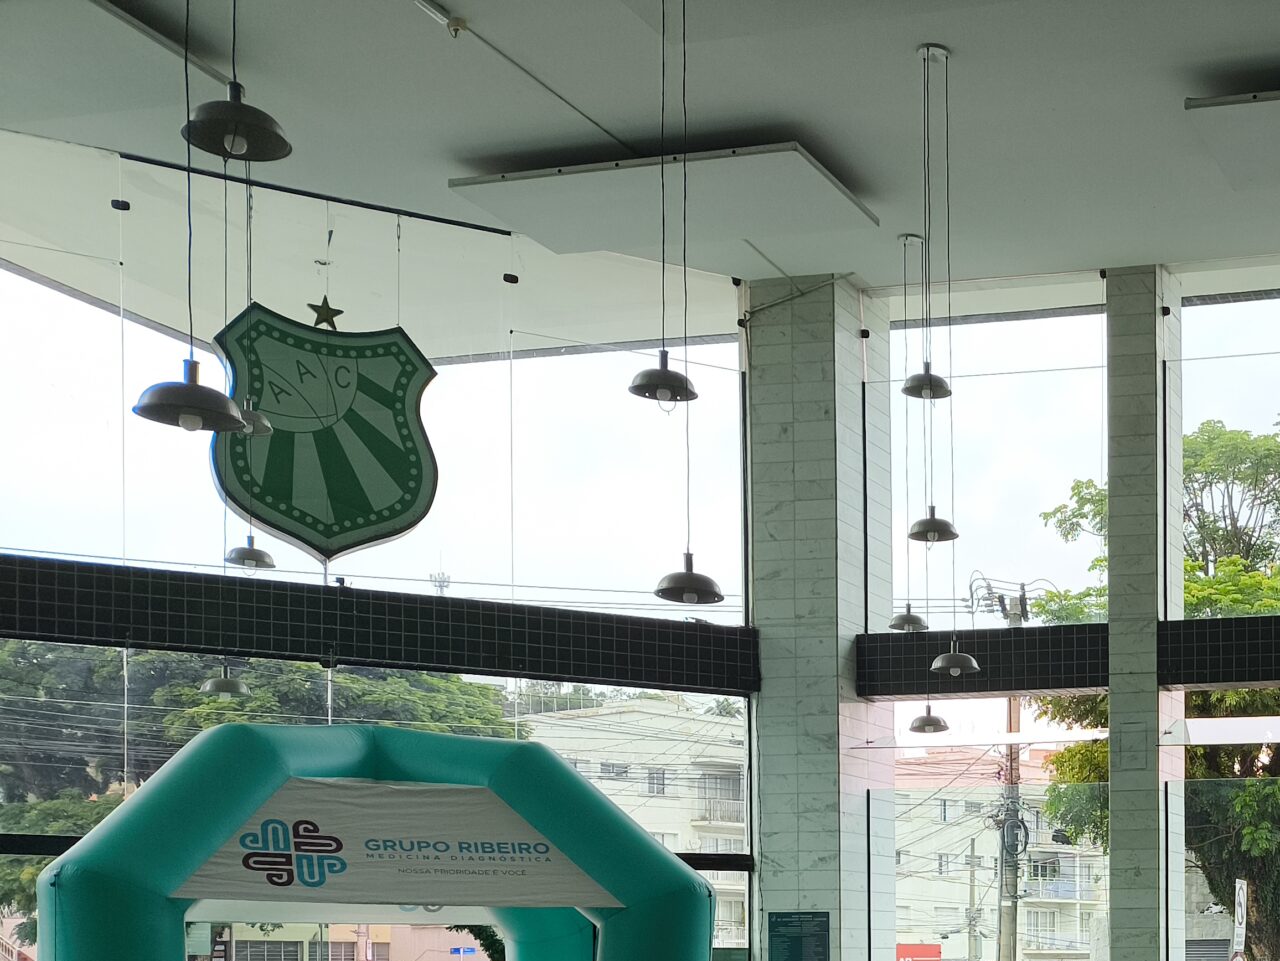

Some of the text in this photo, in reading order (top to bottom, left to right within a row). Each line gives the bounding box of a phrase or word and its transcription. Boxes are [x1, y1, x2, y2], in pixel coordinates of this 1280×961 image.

[364, 839, 550, 855] GRUPO RIBEIRO
[365, 853, 552, 863] MEDICINA DIAGNÓSTICA
